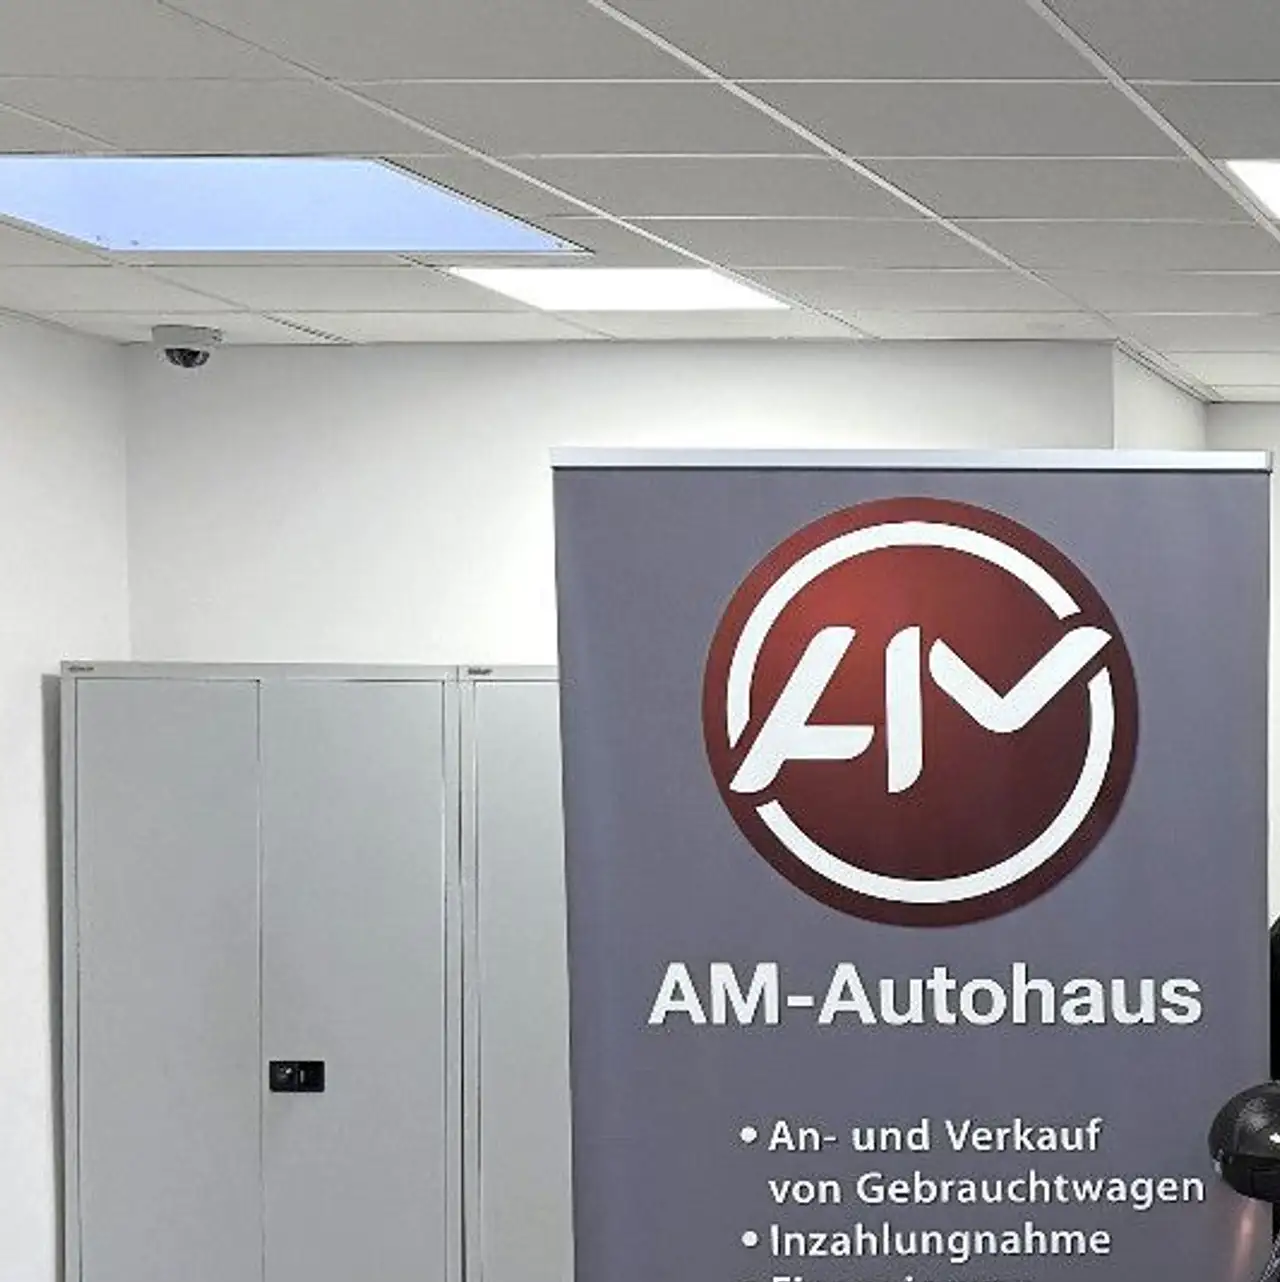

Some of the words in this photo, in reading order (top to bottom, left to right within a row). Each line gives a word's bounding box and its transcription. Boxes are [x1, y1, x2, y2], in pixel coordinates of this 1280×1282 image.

[646, 961, 1203, 1026] AM-Autohaus
[767, 1119, 838, 1152] An-
[851, 1118, 931, 1152] und
[944, 1117, 1104, 1152] Verkauf
[767, 1179, 842, 1204] von
[855, 1169, 1205, 1211] Gebrauchtwagen
[769, 1221, 1111, 1264] Inzahlungnahme
